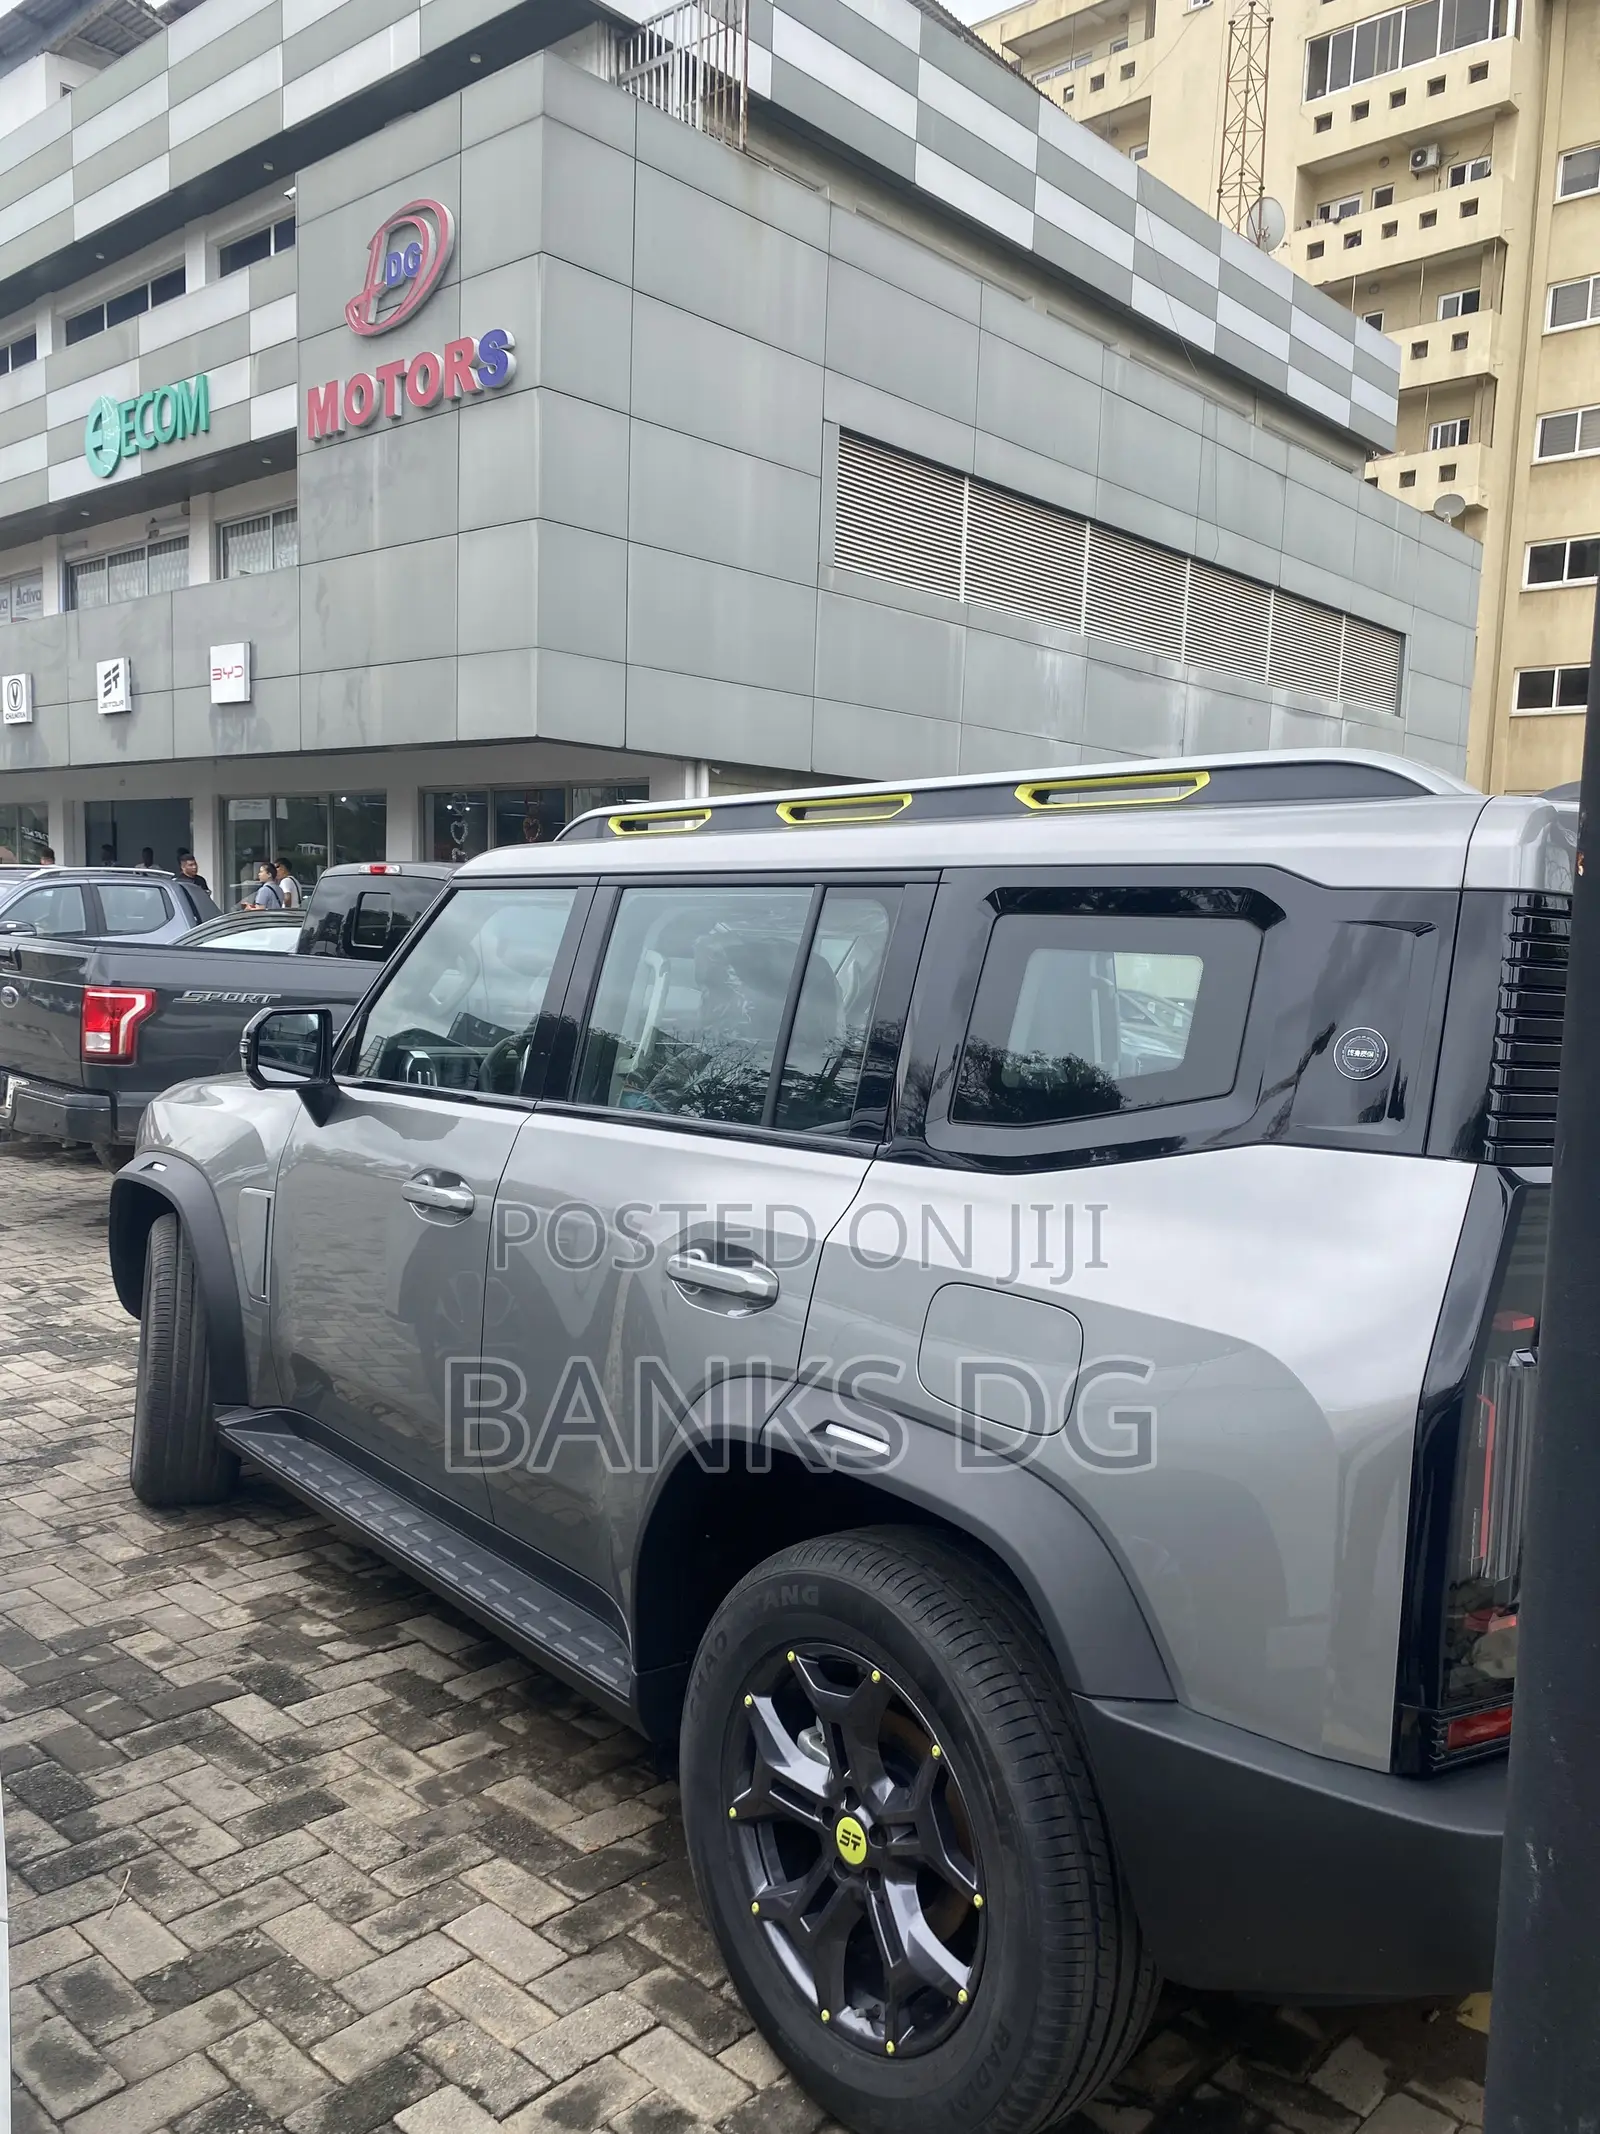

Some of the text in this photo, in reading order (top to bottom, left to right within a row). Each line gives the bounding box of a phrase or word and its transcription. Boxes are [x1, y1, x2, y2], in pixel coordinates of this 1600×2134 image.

[385, 242, 424, 287] DG
[307, 328, 517, 441] MOTORS
[118, 373, 210, 458] ECOM
[212, 664, 245, 681] BYD
[100, 699, 125, 709] JETOUR
[172, 990, 281, 1003] SPORT
